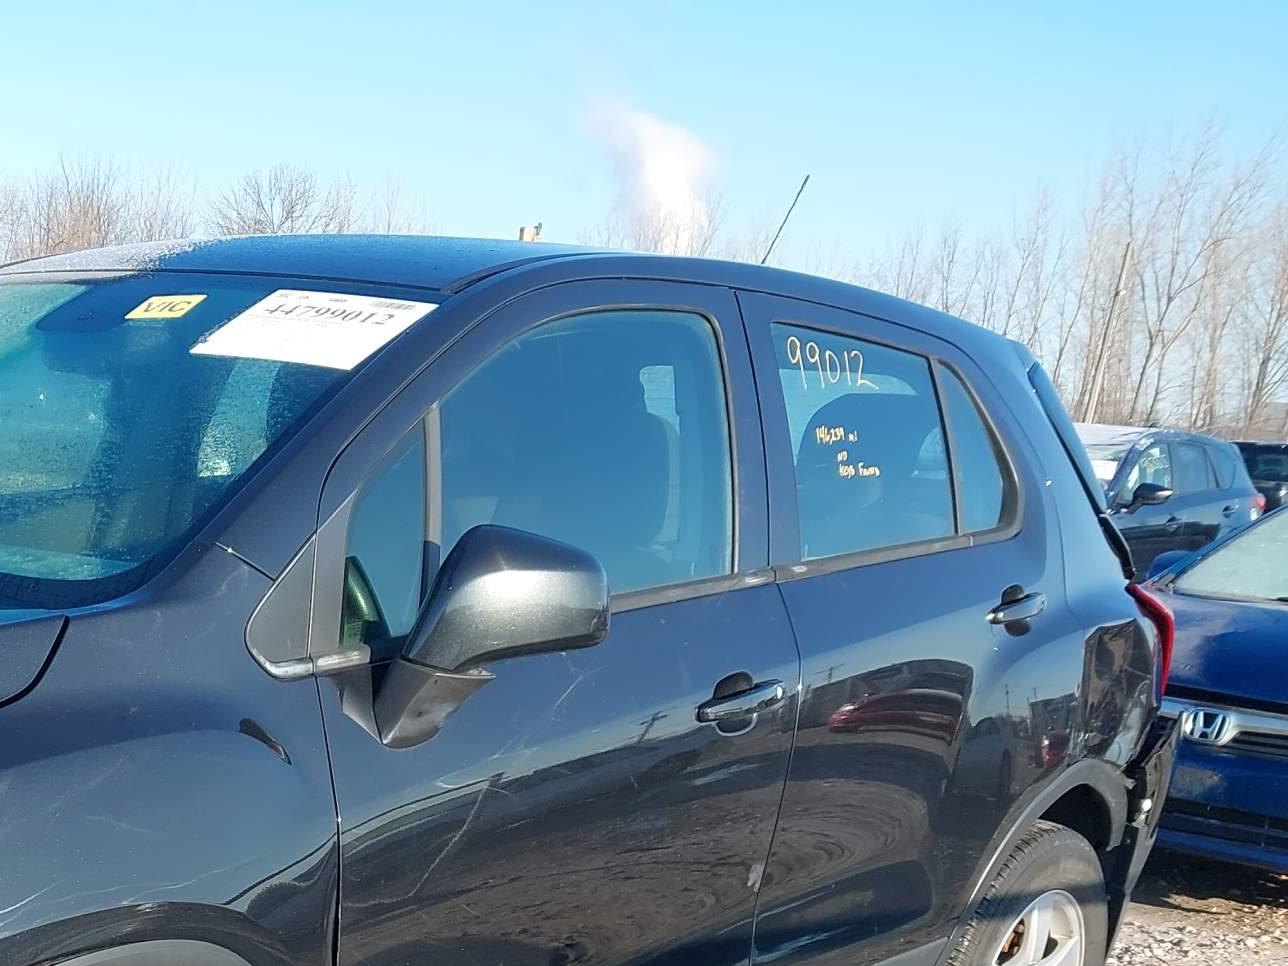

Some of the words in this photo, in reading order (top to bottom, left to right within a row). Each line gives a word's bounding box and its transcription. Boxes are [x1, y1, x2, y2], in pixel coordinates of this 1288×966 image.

[143, 300, 192, 313] VIC
[264, 303, 395, 326] 44799012
[787, 336, 880, 390] 99012
